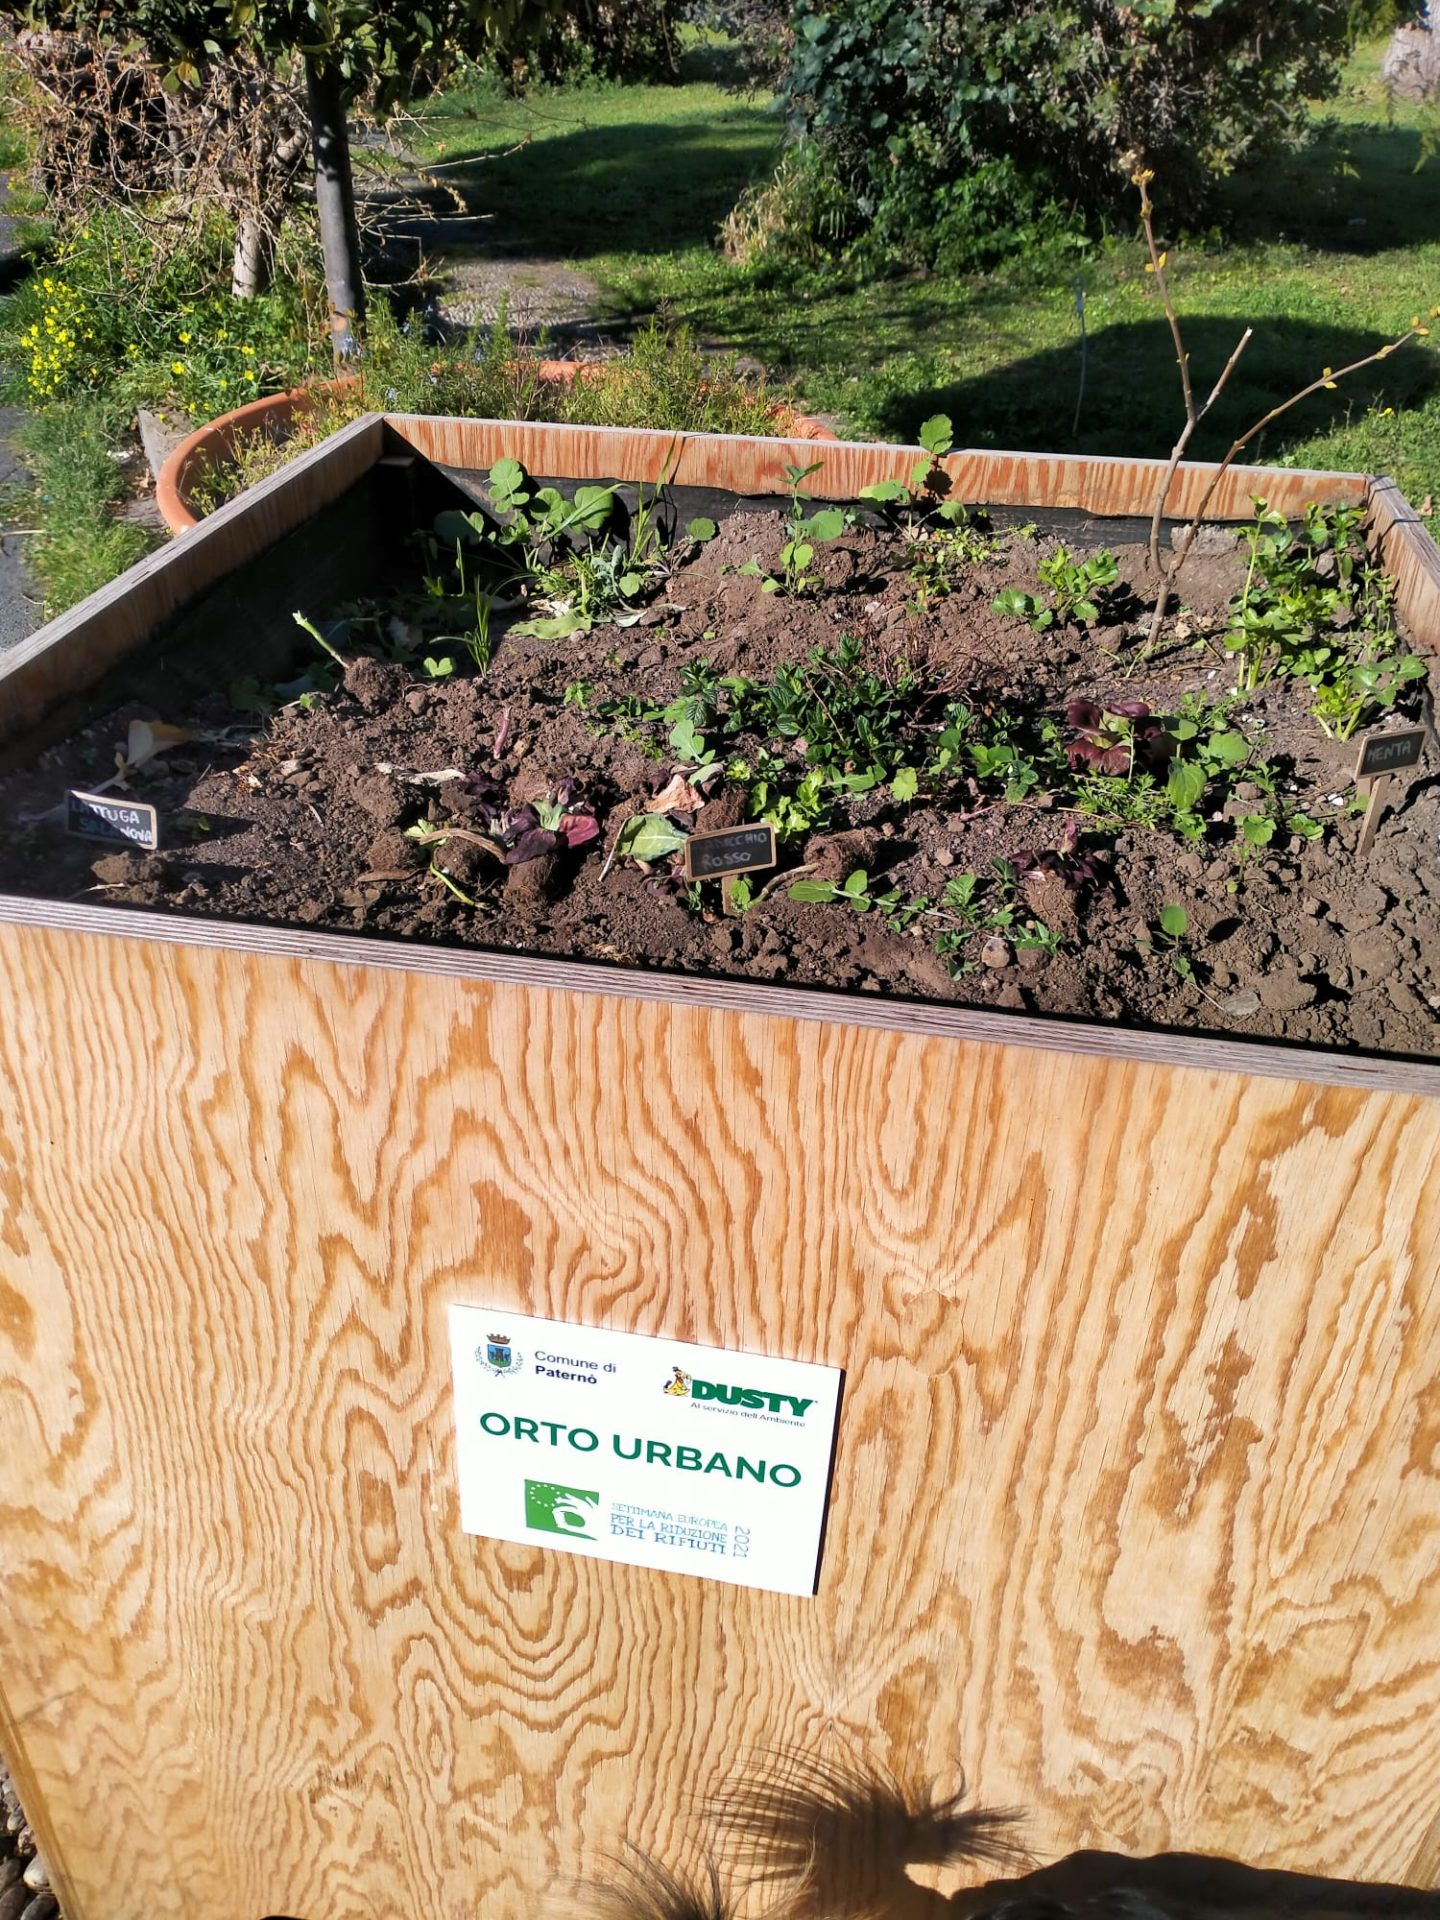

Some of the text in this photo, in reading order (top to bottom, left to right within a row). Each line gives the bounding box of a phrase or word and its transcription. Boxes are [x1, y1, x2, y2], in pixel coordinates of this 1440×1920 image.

[1367, 740, 1412, 762] MENTA
[698, 832, 768, 850] ADICCHIO
[702, 852, 752, 870] ROSSO
[534, 1350, 617, 1373] Comune di
[535, 1365, 598, 1385] Paternò
[692, 1379, 814, 1417] DUSTY
[703, 1405, 739, 1416] servizio
[741, 1411, 806, 1428] dellAmbiente
[480, 1412, 802, 1488] ORTO URBANO
[610, 1513, 728, 1543] PER LA RIDUZIONE
[611, 1502, 728, 1531] SETTIMANA EUROPEA
[610, 1524, 727, 1555] DEI RIFIUTI
[732, 1525, 751, 1558] 2021
